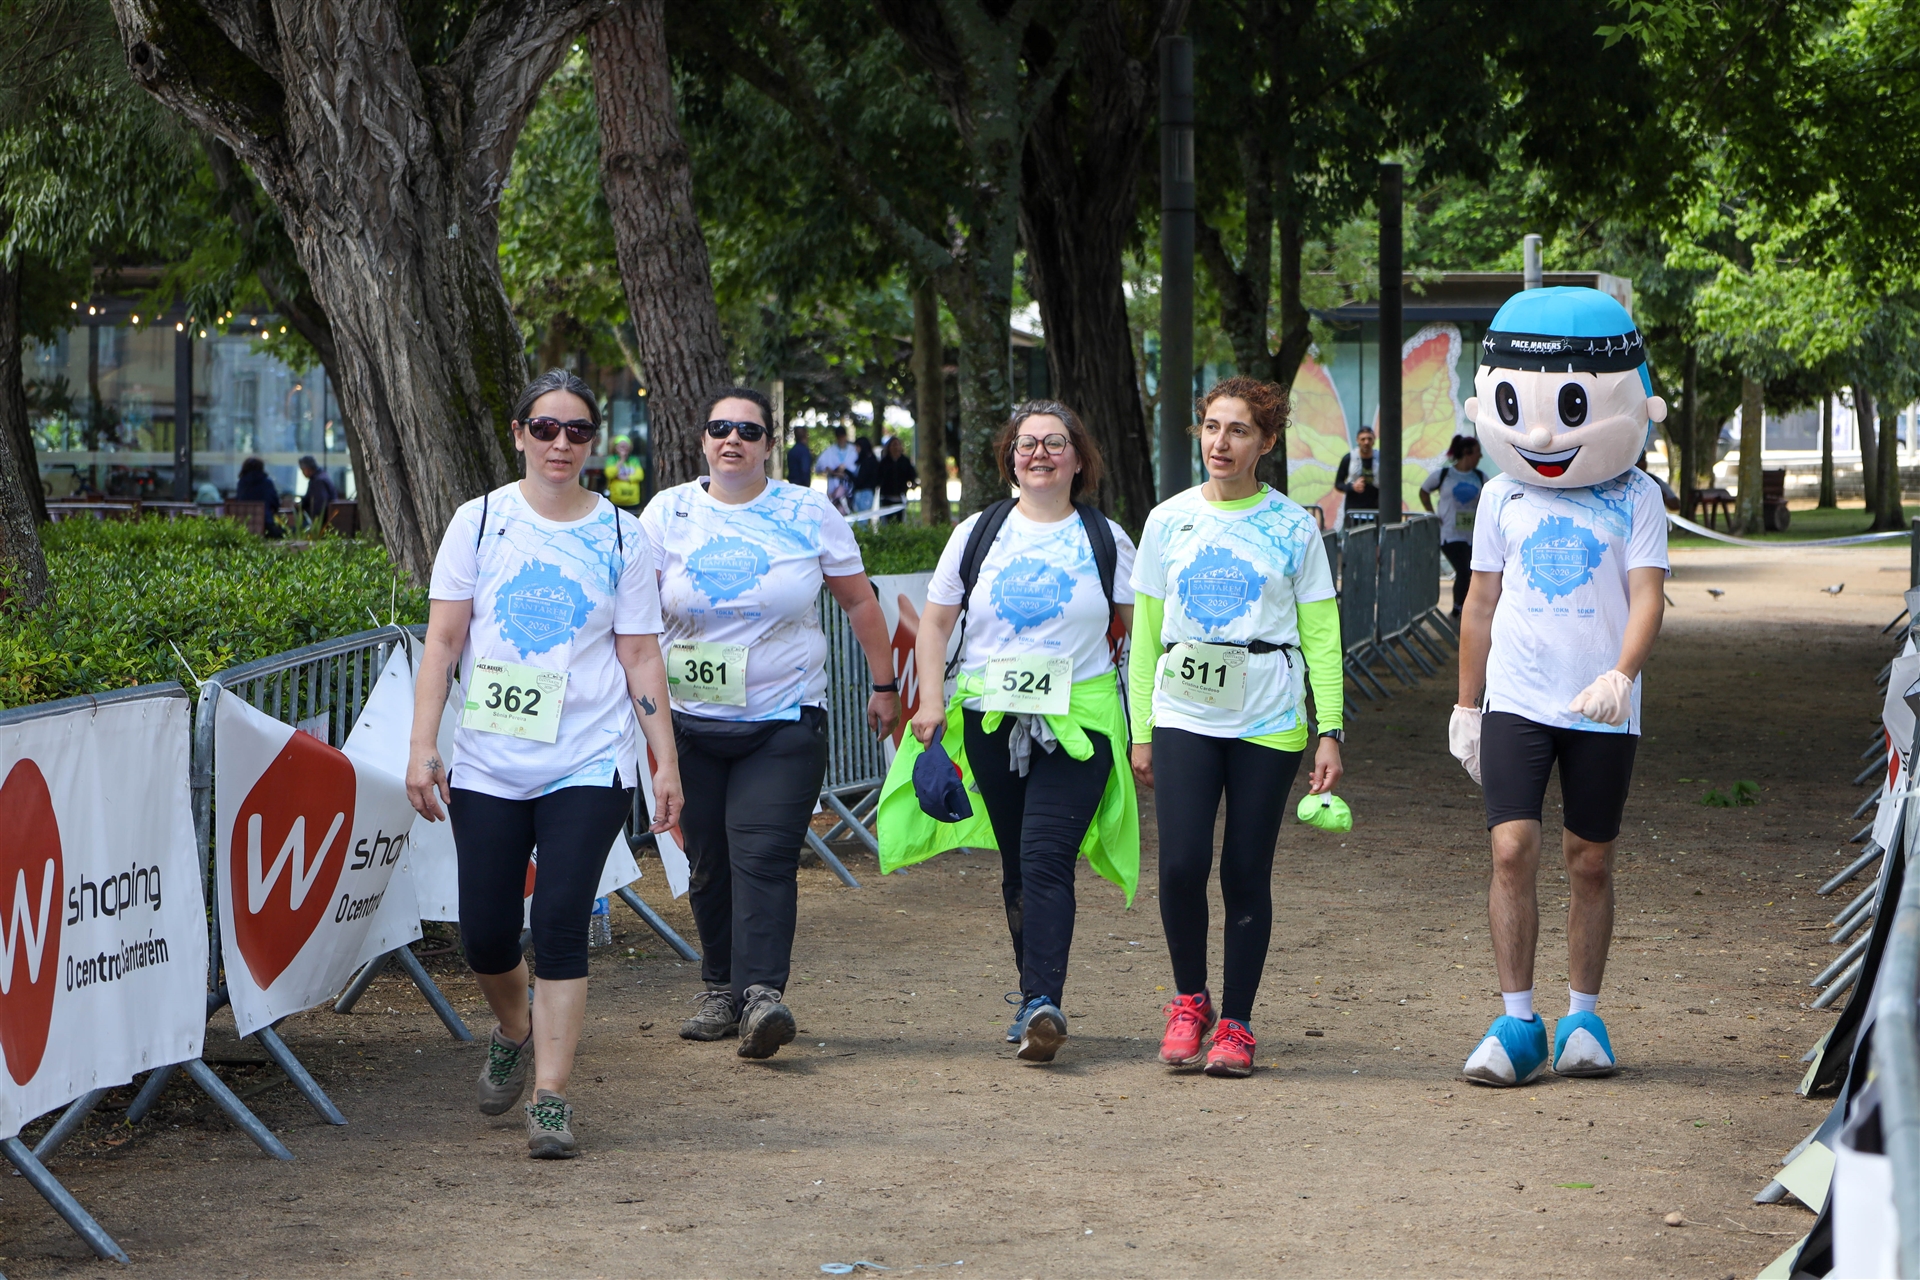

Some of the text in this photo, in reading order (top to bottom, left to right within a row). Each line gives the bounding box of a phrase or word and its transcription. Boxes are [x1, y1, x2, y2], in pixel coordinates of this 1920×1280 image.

[1511, 339, 1562, 350] PACE MAKERS
[1192, 583, 1242, 593] SANTARÉM
[512, 600, 568, 617] SANTARÉM
[684, 659, 726, 685] 361
[1002, 670, 1052, 695] 524
[1180, 656, 1227, 688] 511
[485, 682, 541, 717] 362
[1181, 680, 1199, 690] Cristina
[1200, 685, 1220, 694] Cardoso
[67, 861, 162, 926] shoping
[66, 928, 169, 992] O centro Santarém
